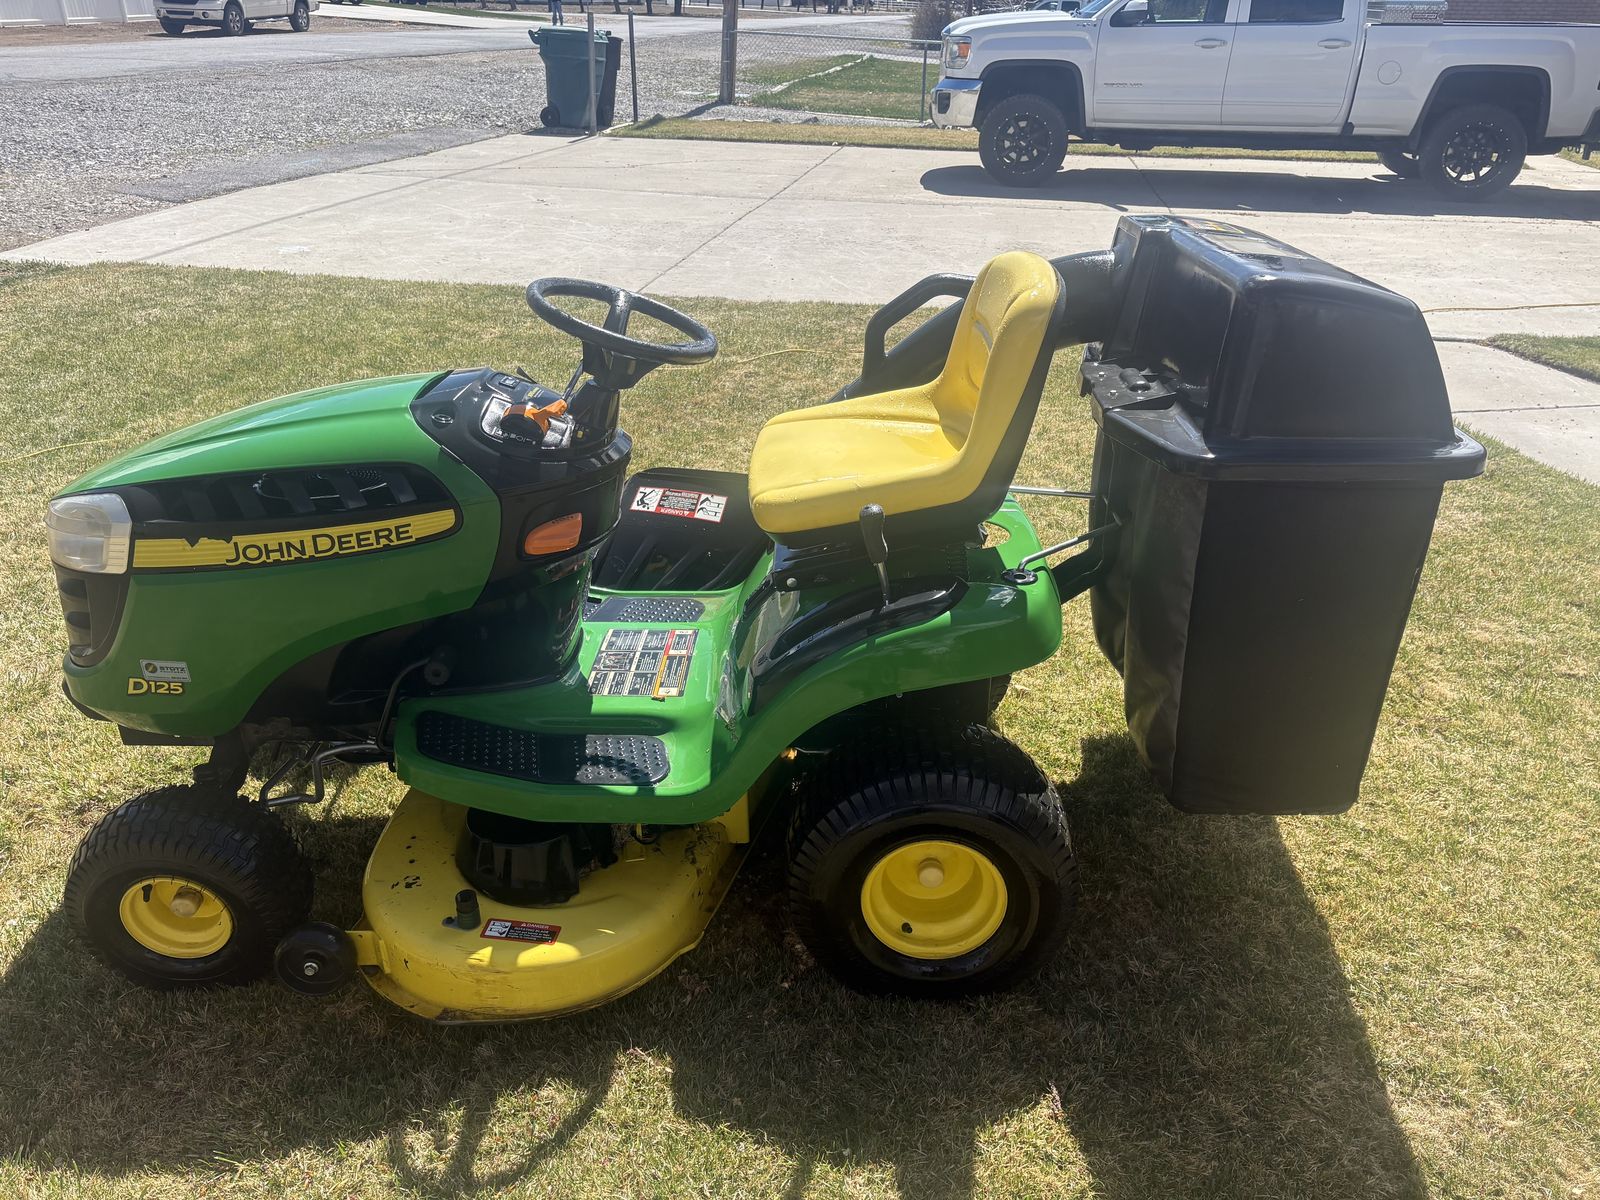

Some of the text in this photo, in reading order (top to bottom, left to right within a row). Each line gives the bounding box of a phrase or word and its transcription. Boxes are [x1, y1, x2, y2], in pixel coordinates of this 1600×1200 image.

[225, 523, 413, 564] JOHN DEERE
[127, 678, 183, 695] D125
